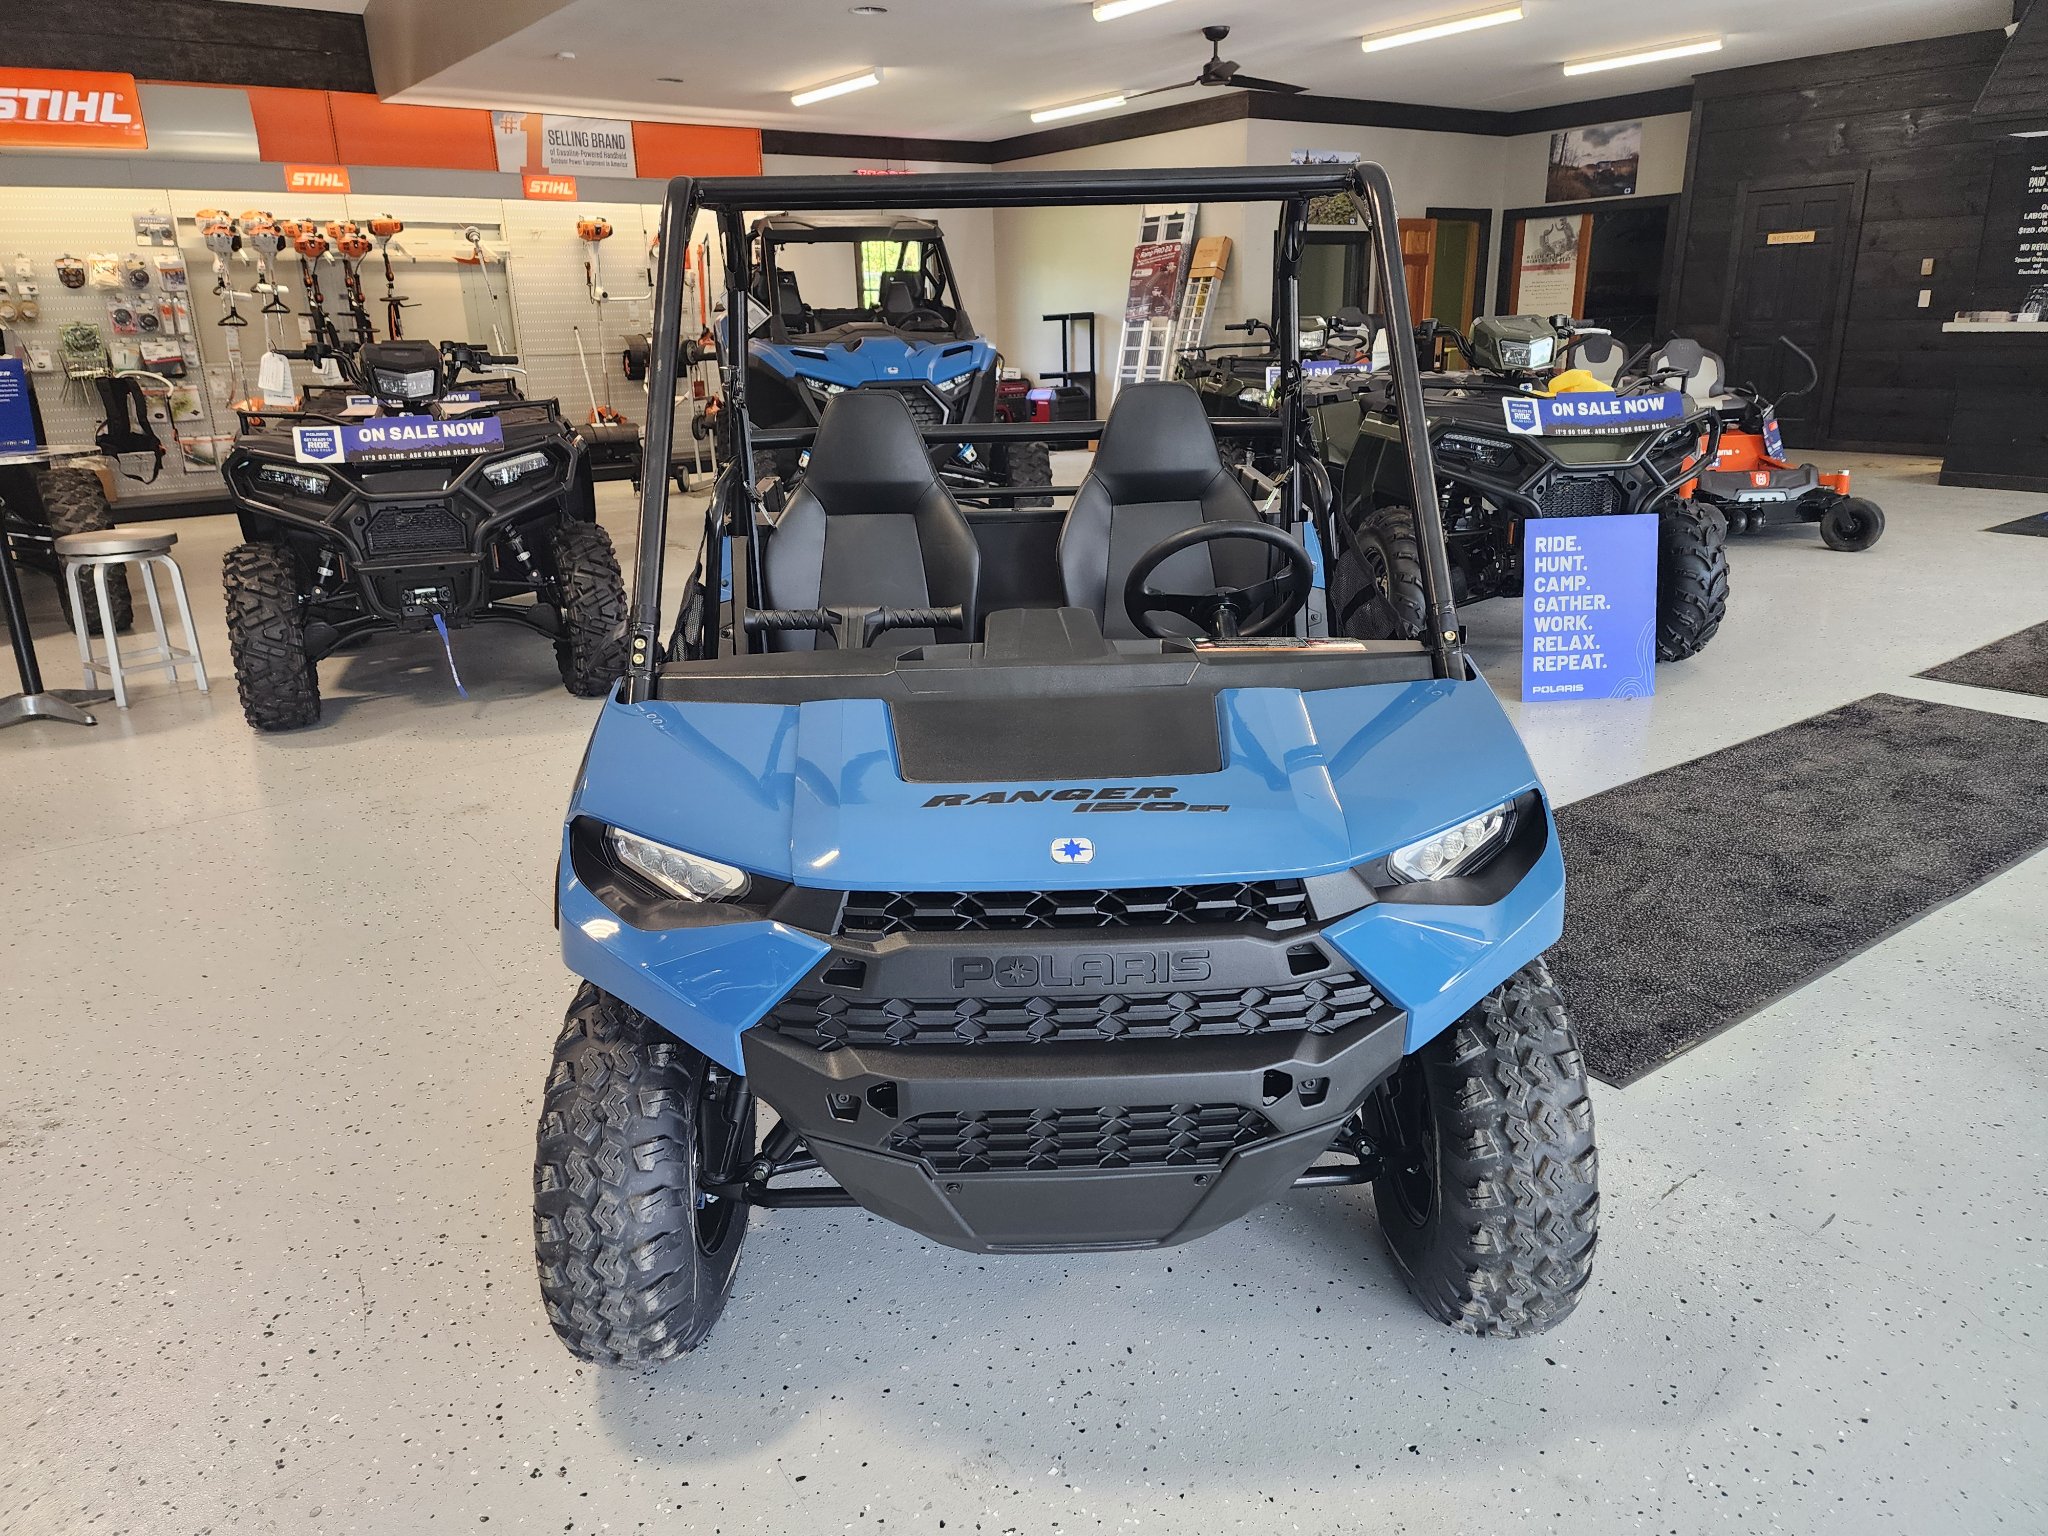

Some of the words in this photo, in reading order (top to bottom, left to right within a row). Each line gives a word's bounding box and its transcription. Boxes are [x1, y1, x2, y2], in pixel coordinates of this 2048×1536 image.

[0, 87, 131, 123] STIHL
[548, 130, 589, 148] SELLING
[591, 133, 626, 150] BRAND
[291, 172, 344, 187] STIHL
[529, 180, 574, 195] STIHL
[2028, 176, 2046, 187] PAID
[2020, 243, 2030, 251] NO
[1551, 402, 1575, 416] ON
[1577, 400, 1622, 416] SALE
[1624, 396, 1665, 414] NOW
[359, 428, 386, 442] ON
[389, 424, 440, 441] SALE
[442, 421, 485, 438] NOW
[1535, 535, 1582, 553] RIDE.
[1534, 555, 1588, 573] HUNT.
[1534, 575, 1591, 593] CAMP.
[1533, 594, 1611, 613] GATHER.
[1533, 614, 1593, 633] WORK.
[1533, 634, 1600, 653] RELAX.
[1533, 653, 1608, 673] REPEAT.
[1532, 683, 1584, 695] POLARIS
[920, 786, 1179, 808] RANGER
[1071, 801, 1189, 813] 150
[951, 949, 1212, 989] POLARIS
